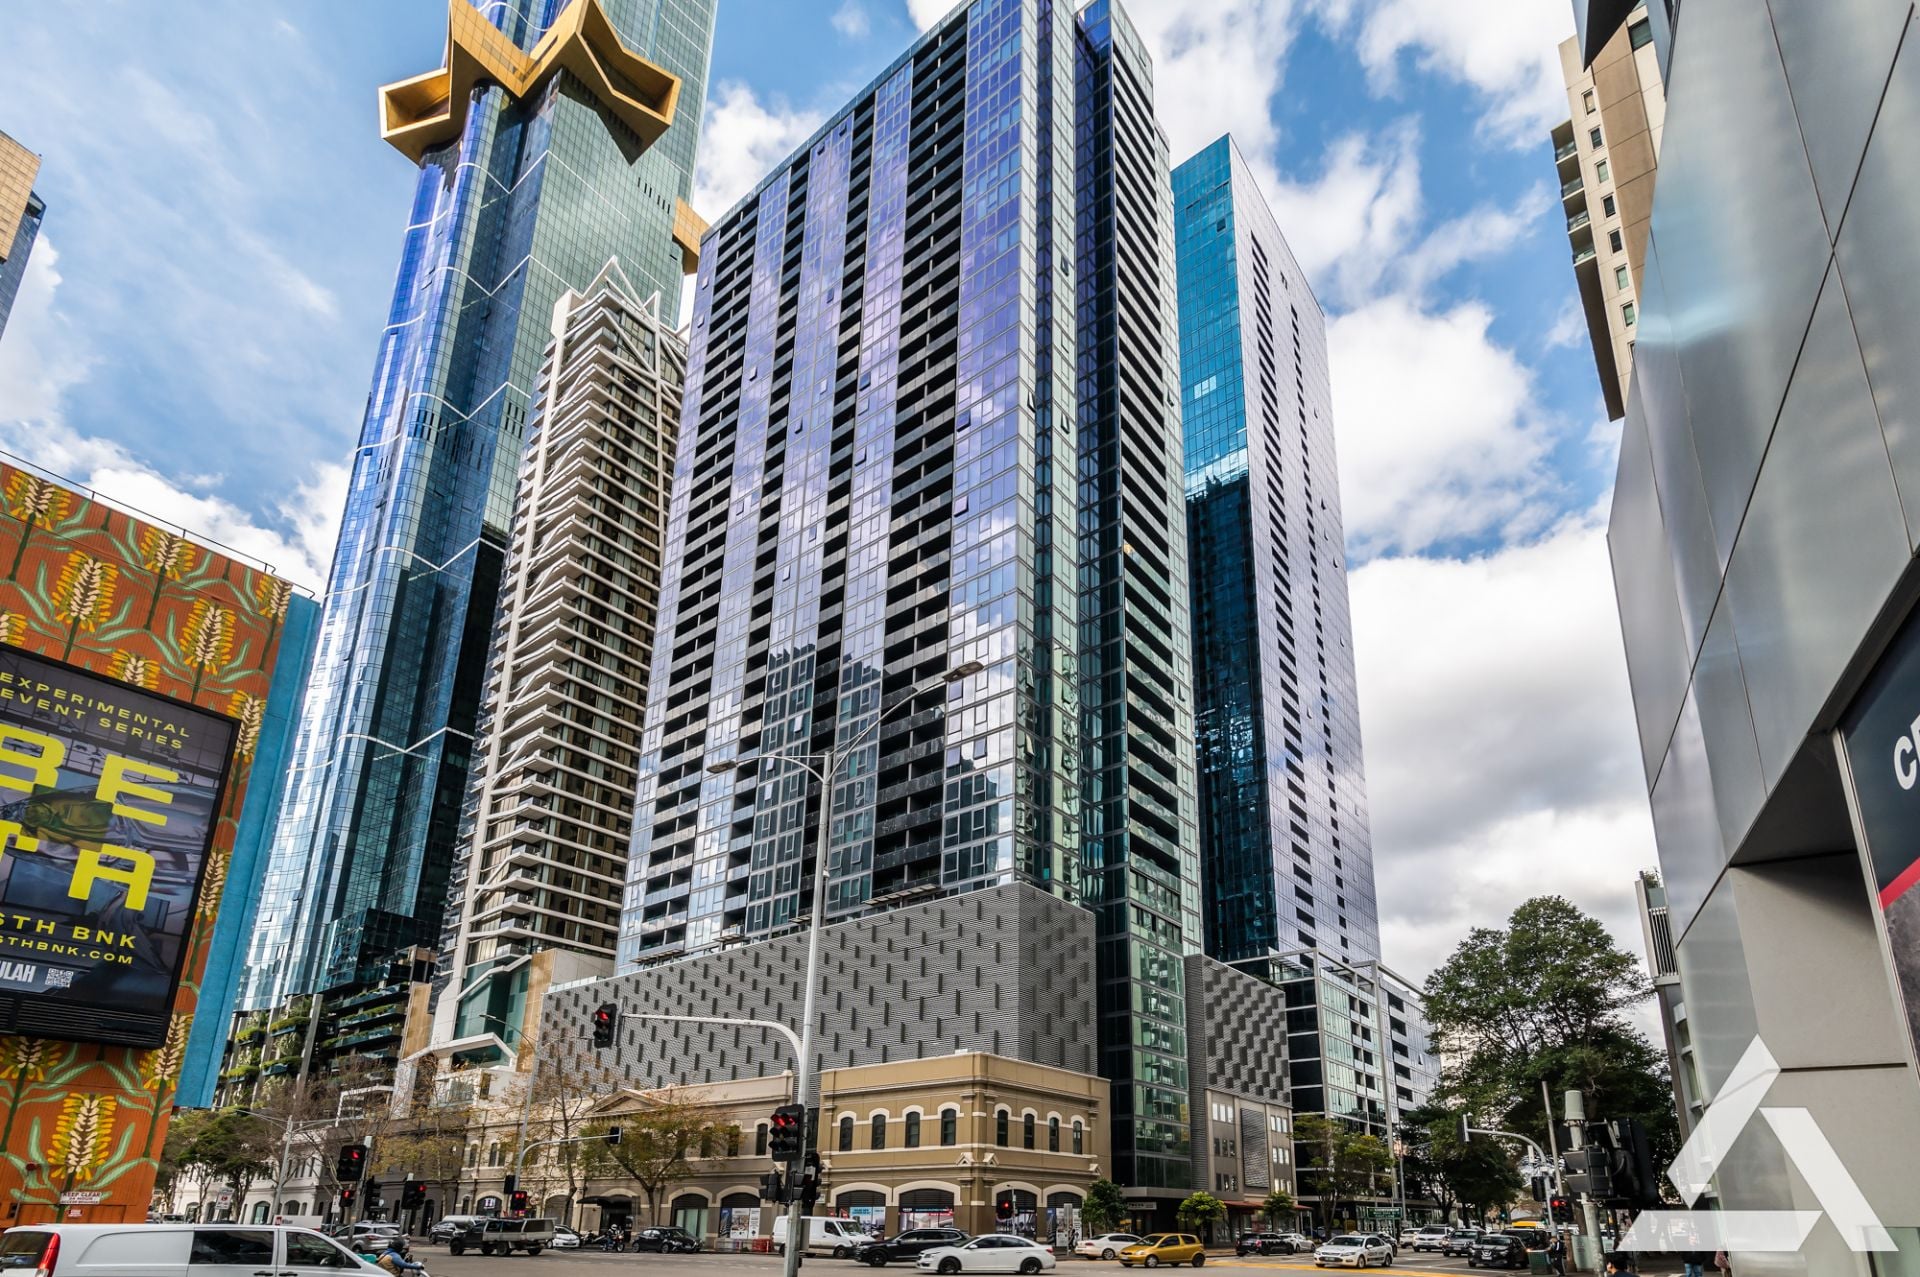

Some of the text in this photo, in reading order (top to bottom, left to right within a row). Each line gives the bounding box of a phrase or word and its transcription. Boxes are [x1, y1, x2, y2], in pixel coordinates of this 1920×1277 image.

[0, 672, 190, 738] EXPERIMENTAL
[0, 688, 182, 750] EVENT SERIES
[0, 723, 180, 827] BE
[72, 925, 136, 949] BNK
